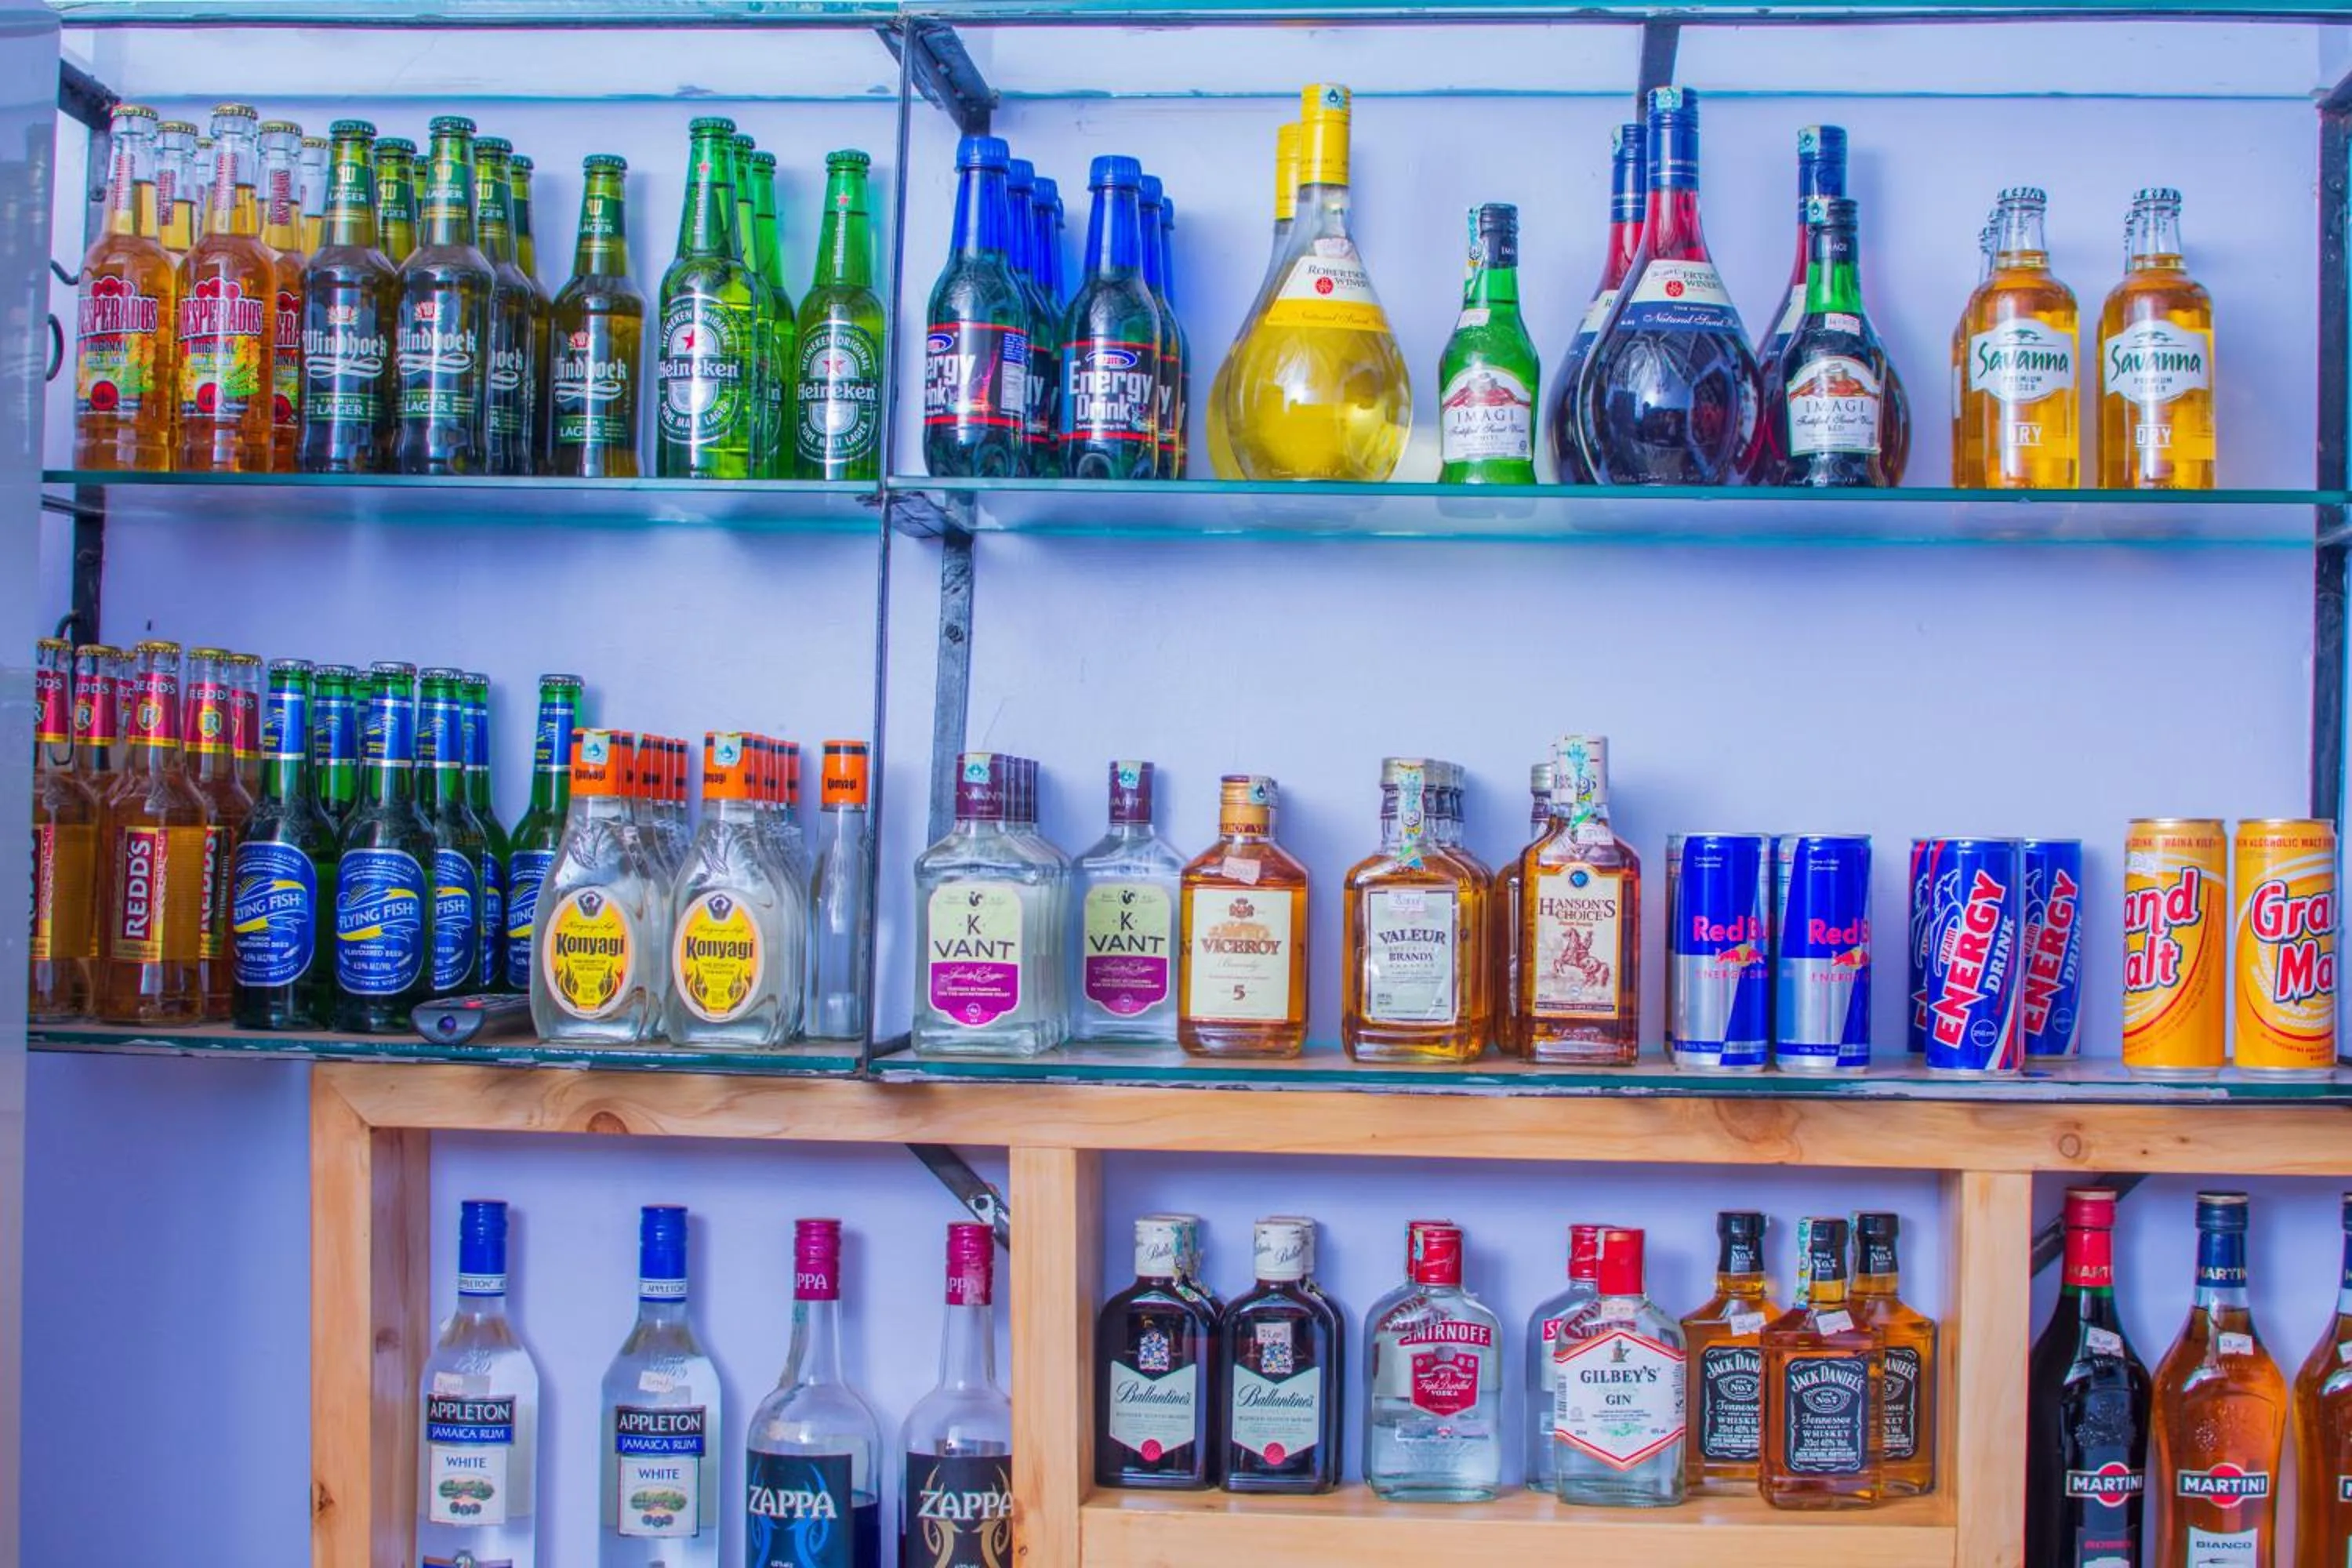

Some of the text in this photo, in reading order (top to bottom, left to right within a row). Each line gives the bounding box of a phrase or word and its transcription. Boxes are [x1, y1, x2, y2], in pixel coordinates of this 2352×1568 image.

[303, 330, 387, 358] Windhoek
[659, 358, 740, 378] Heineken
[1977, 341, 2070, 380] Savanna
[2111, 345, 2201, 382] Savanna
[797, 383, 877, 401] Heineken
[1069, 361, 1152, 405] Energy
[317, 404, 365, 416] LAGER
[405, 401, 448, 412] LAGER
[1077, 394, 1130, 421] Drink
[1457, 408, 1514, 423] IMAGI
[1806, 400, 1864, 413] IMAGI
[2136, 426, 2172, 445] DRY
[125, 840, 151, 938] REDD'S
[270, 893, 301, 910] FISH
[436, 899, 465, 916] FISH
[1538, 898, 1617, 919] HANSON'S
[2125, 866, 2201, 938] and
[2252, 880, 2335, 941] Gra
[339, 902, 415, 929] FLYING FISH
[967, 913, 980, 936] K
[1120, 910, 1134, 931] K
[1555, 909, 1604, 921] CHOICE
[1378, 927, 1446, 946] VALEUR
[1693, 915, 1745, 942] Red
[1809, 917, 1859, 946] Red
[555, 932, 625, 958] Konyagi
[686, 936, 754, 960] Konyagi
[934, 939, 1015, 960] VANT
[1089, 934, 1166, 954] VANT
[1201, 939, 1283, 956] VICEROY
[1388, 953, 1434, 962] BRANDY
[1930, 869, 2006, 1050] ENERGY
[1985, 916, 2016, 995] DRINK
[2125, 935, 2181, 991] alt
[2275, 939, 2336, 1004] Ma
[1233, 984, 1247, 1001] 5
[797, 1273, 829, 1290] PPA
[2198, 1266, 2248, 1281] MARTIN
[948, 1276, 982, 1294] PPA
[1580, 1366, 1657, 1385] GILBEY'S
[1707, 1358, 1734, 1379] JACK
[1790, 1365, 1865, 1393] JACK DANIEL'S
[1116, 1380, 1192, 1406] Ballantine's
[1237, 1383, 1315, 1409] Ballantine's
[1606, 1394, 1632, 1406] GIN
[430, 1399, 511, 1421] APPLETON
[1802, 1412, 1851, 1425] Tennessee
[619, 1413, 702, 1432] APPLETON
[432, 1427, 505, 1439] JAMAICA RUM
[622, 1439, 698, 1451] JAMAICA RUM
[446, 1456, 487, 1468] WHITE
[638, 1468, 681, 1479] WHITE
[2073, 1475, 2143, 1491] MARTINI
[2183, 1476, 2266, 1494] MARTINI
[749, 1485, 838, 1519] ZAPPA
[916, 1490, 1014, 1519] ZAPPA
[2195, 1540, 2253, 1550] BIANCO
